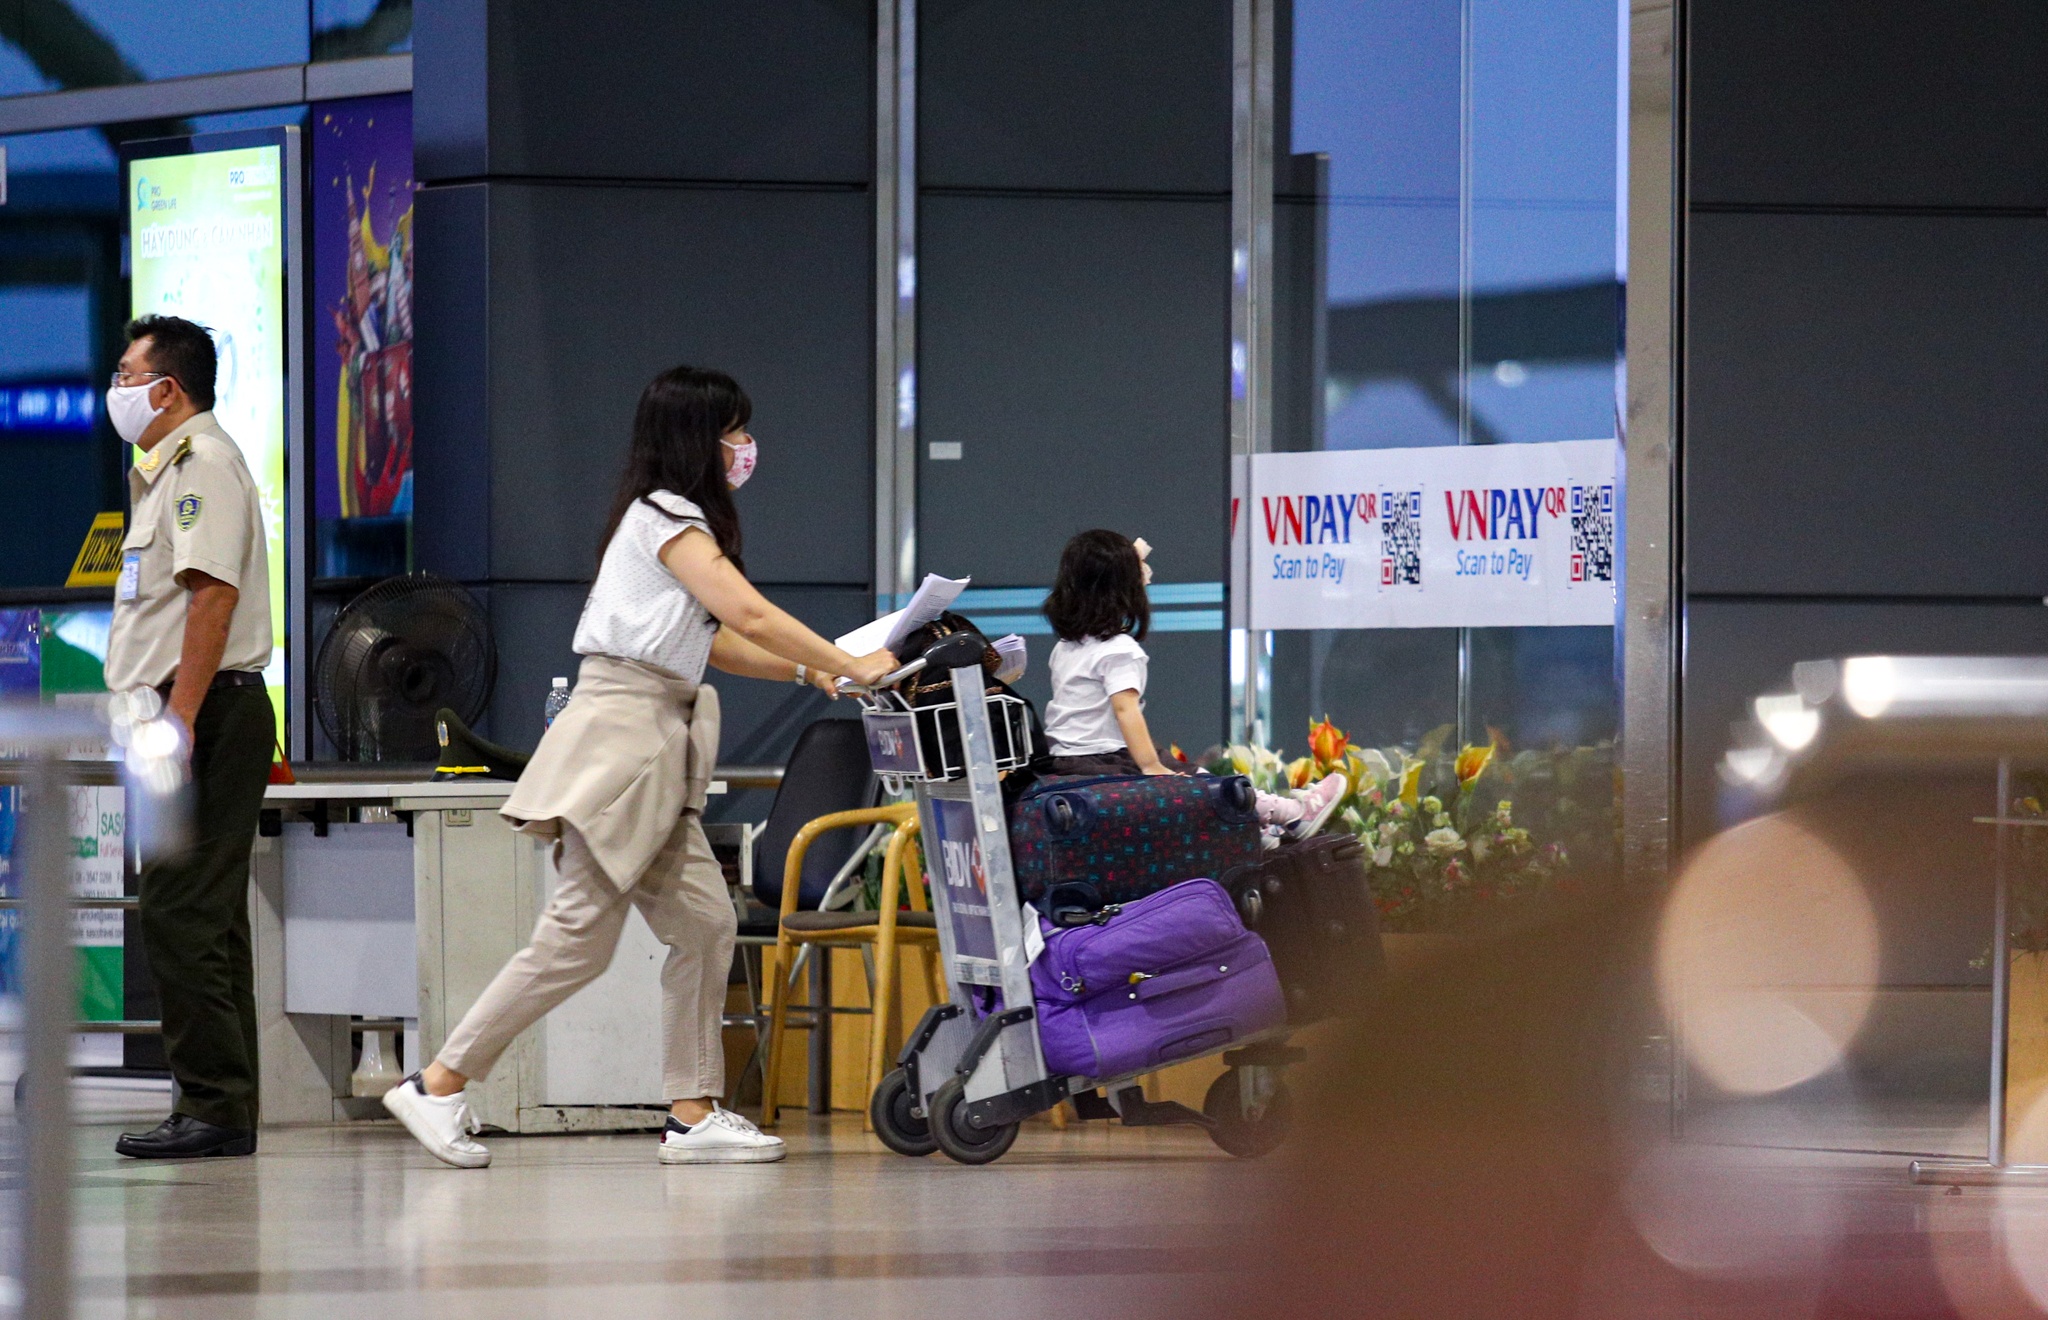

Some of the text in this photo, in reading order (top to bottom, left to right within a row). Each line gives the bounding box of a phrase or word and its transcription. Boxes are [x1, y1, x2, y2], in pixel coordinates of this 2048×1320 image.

[1261, 494, 1357, 546] VNPAY
[1444, 487, 1545, 541] VNPAY
[77, 527, 124, 573] VIETRA
[1272, 552, 1345, 584] Scan to Pay
[1456, 548, 1533, 581] Scan to Pay
[941, 840, 972, 888] BIDV
